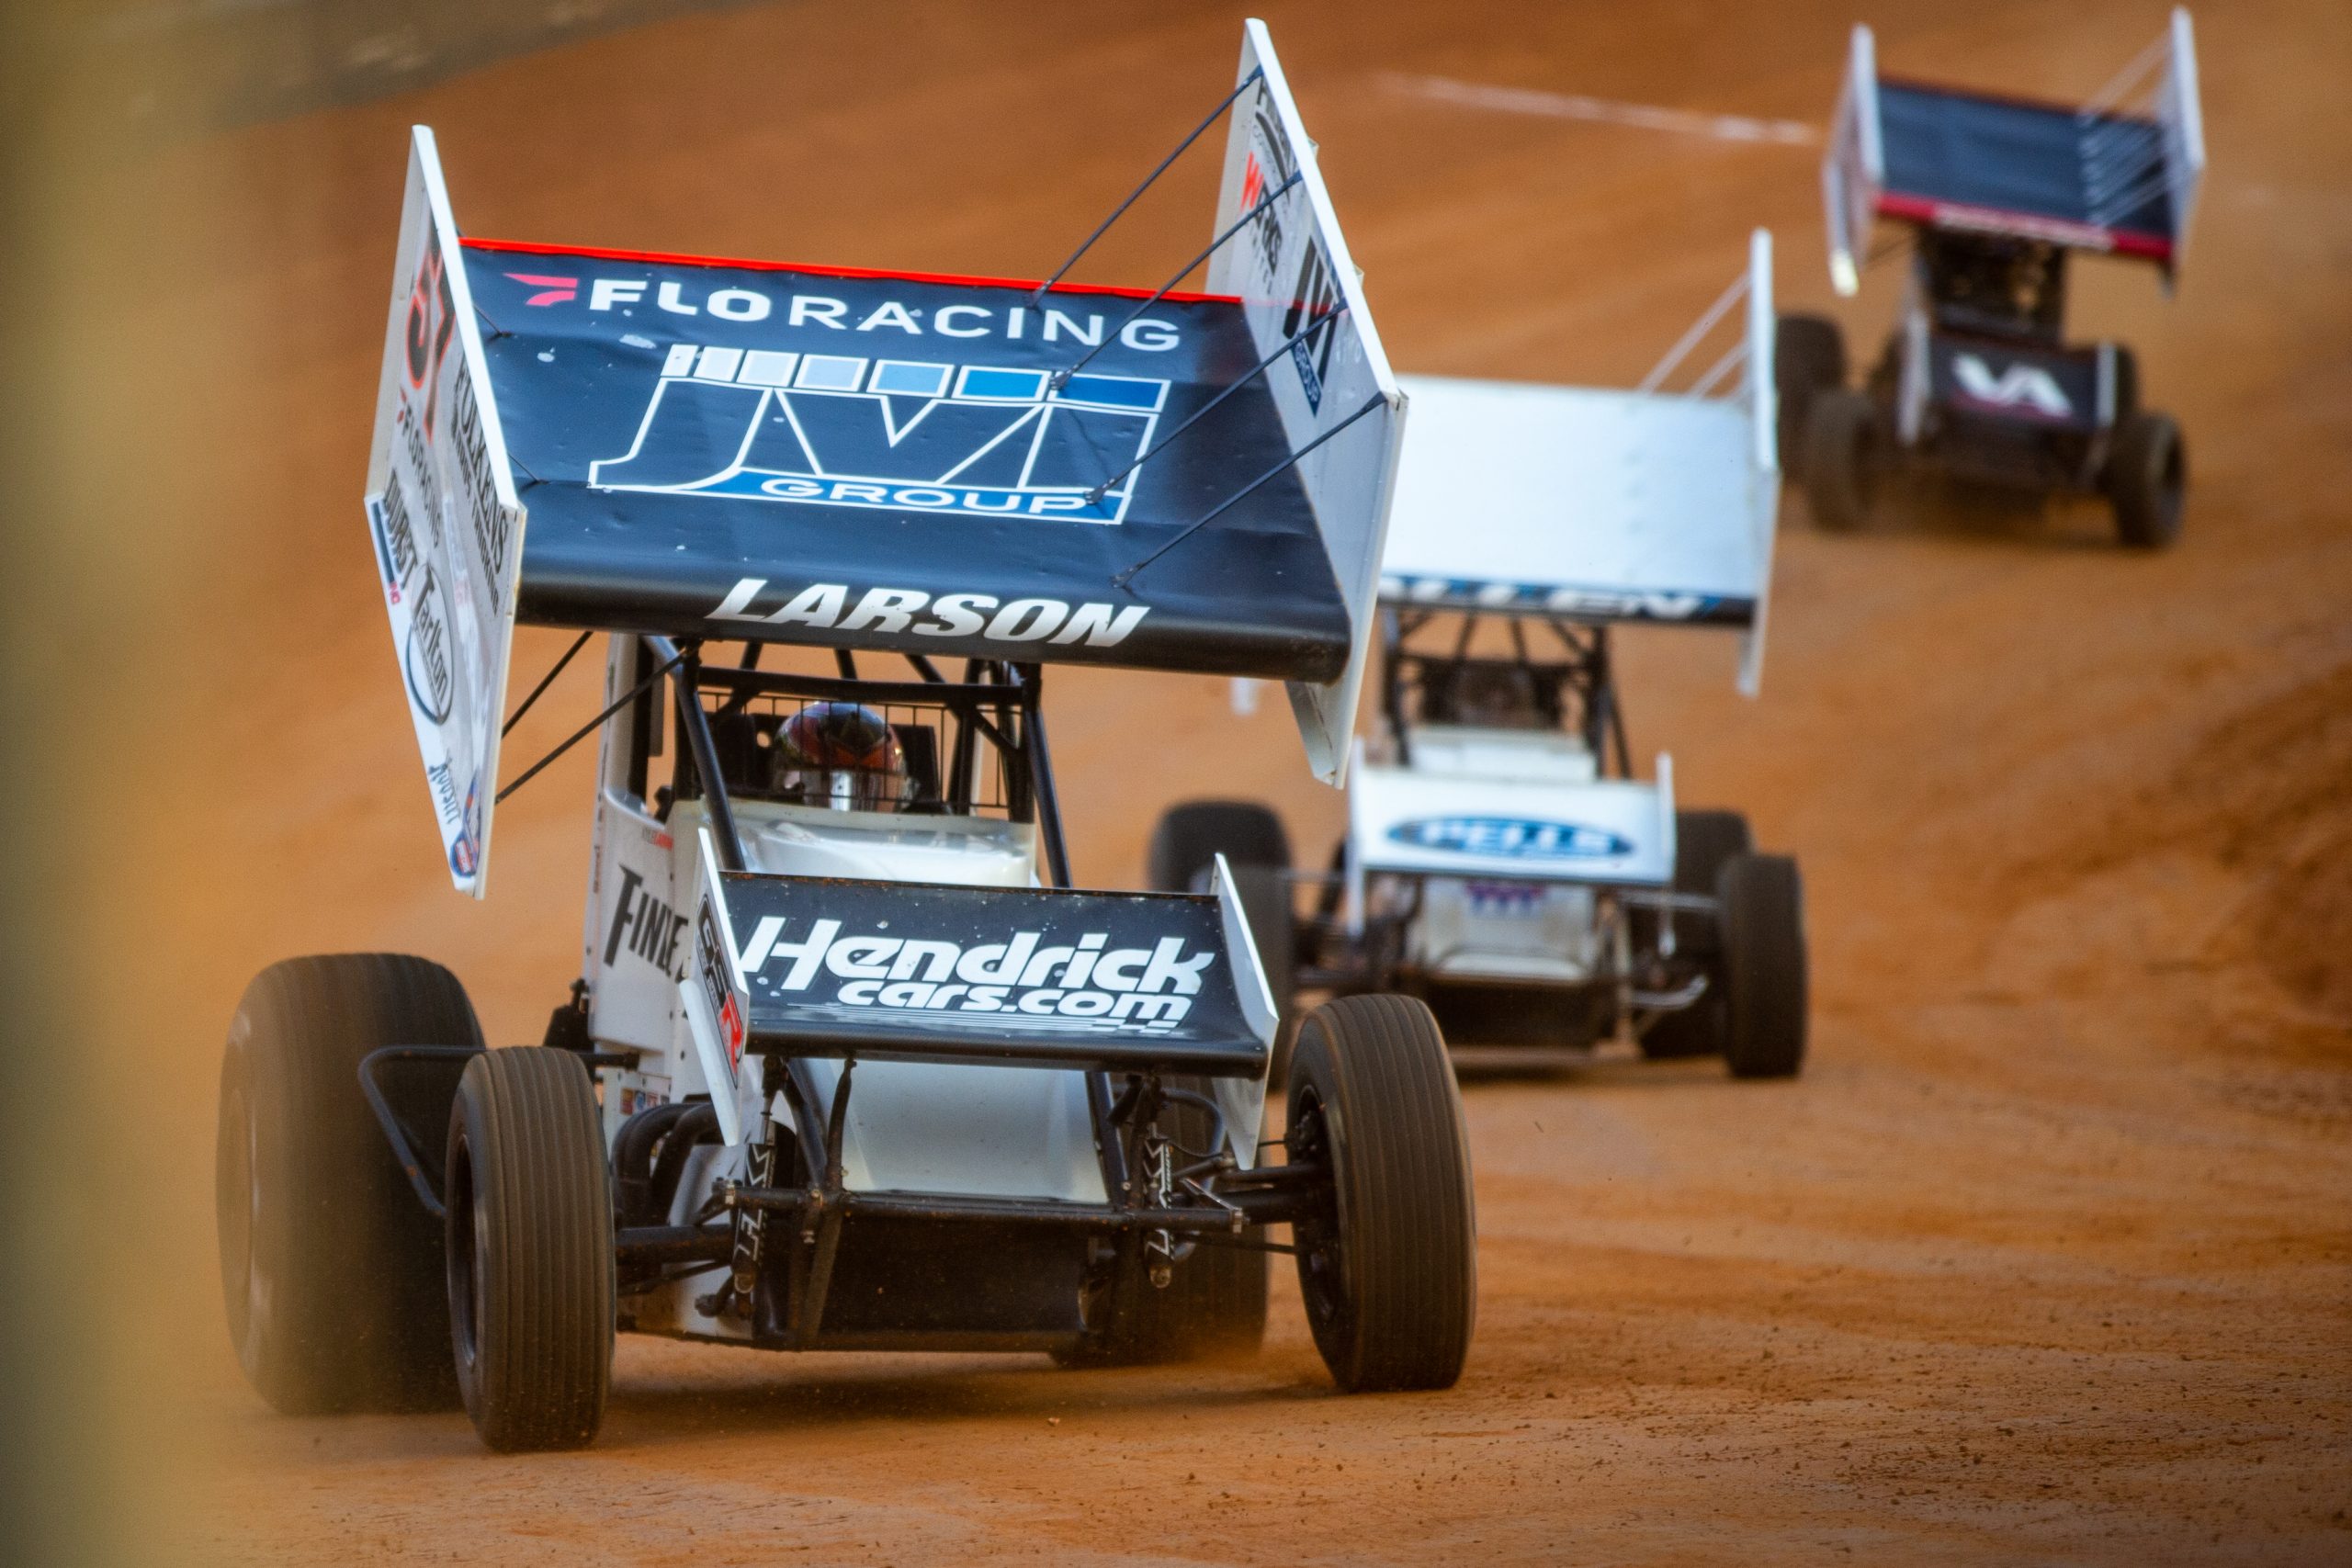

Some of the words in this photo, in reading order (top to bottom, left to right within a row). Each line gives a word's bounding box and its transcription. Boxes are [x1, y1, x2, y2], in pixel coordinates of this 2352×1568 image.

[588, 278, 1182, 353] FLORACING
[760, 478, 1087, 516] GROUP
[412, 563, 449, 704] Tarlton
[706, 578, 1151, 648] LARSON
[738, 917, 1215, 994] Hendrick
[837, 979, 1194, 1021] cars.com
